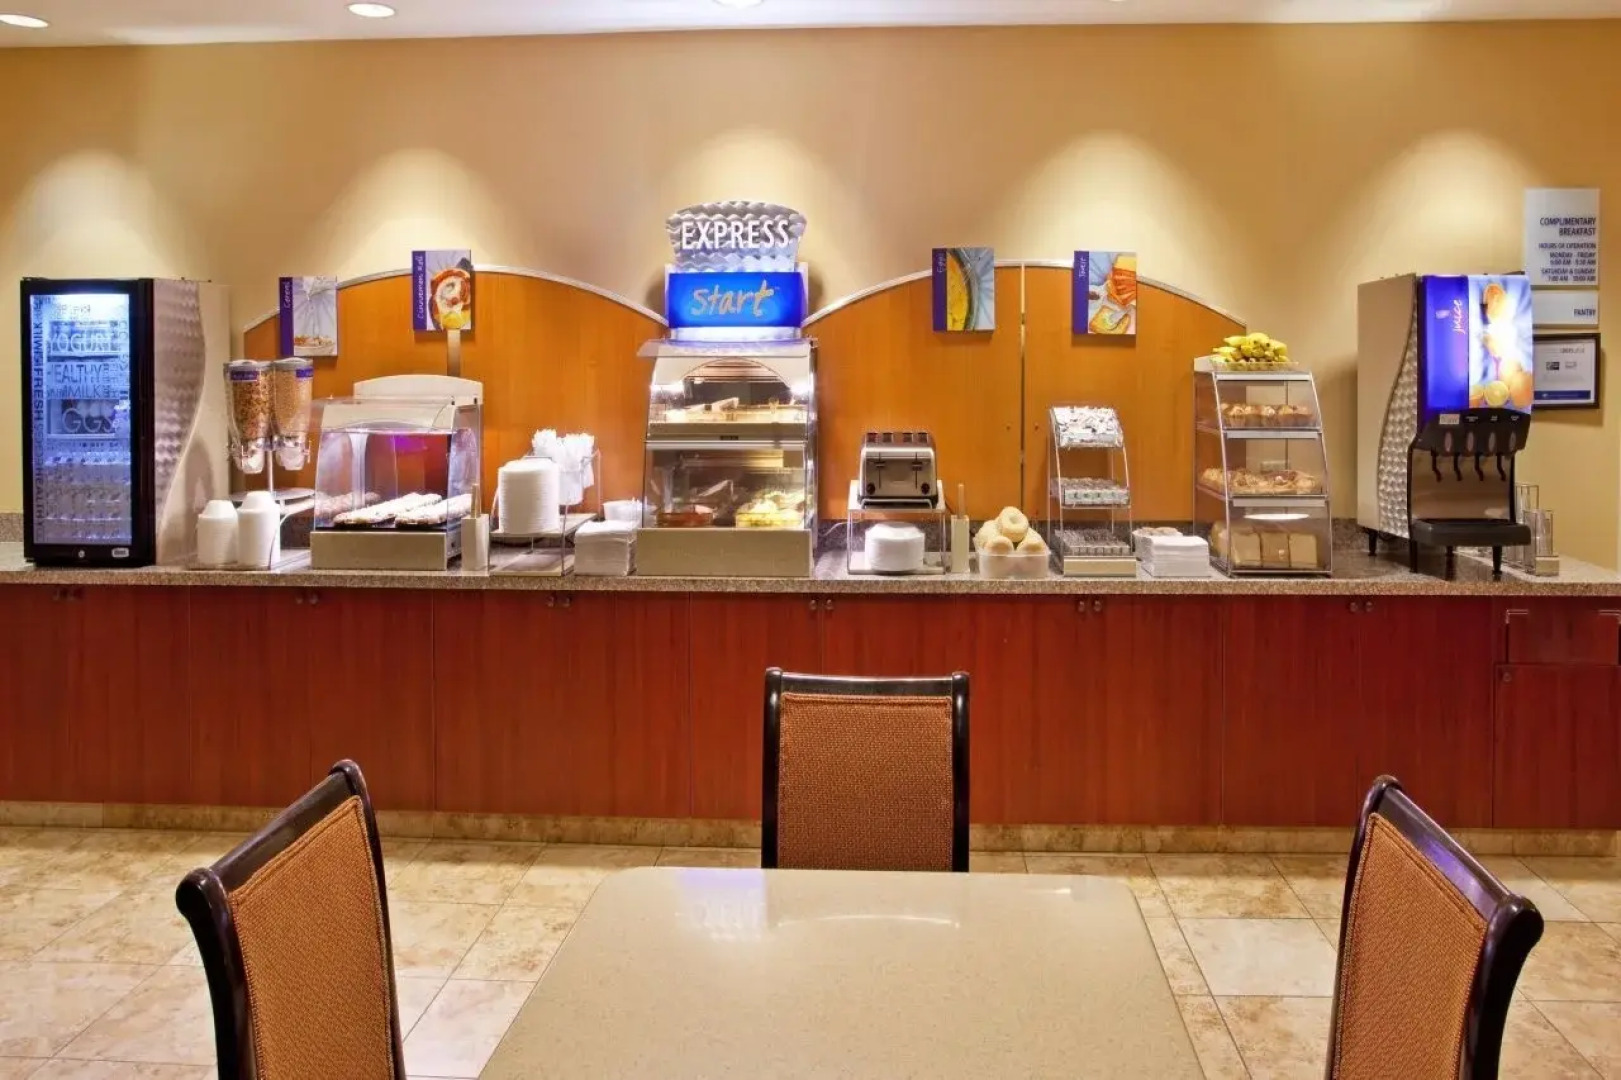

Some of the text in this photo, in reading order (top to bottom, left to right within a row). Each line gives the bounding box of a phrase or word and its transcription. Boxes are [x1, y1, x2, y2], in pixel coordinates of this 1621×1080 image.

[1540, 217, 1597, 226] COMPLIMENTARY
[1559, 227, 1597, 236] BREAKFAST
[682, 220, 789, 250] EXPRESS
[690, 279, 775, 317] Start
[1574, 308, 1597, 317] PANTRY
[33, 368, 44, 421] FRESH
[67, 384, 101, 398] MILK
[55, 407, 114, 434] GGS
